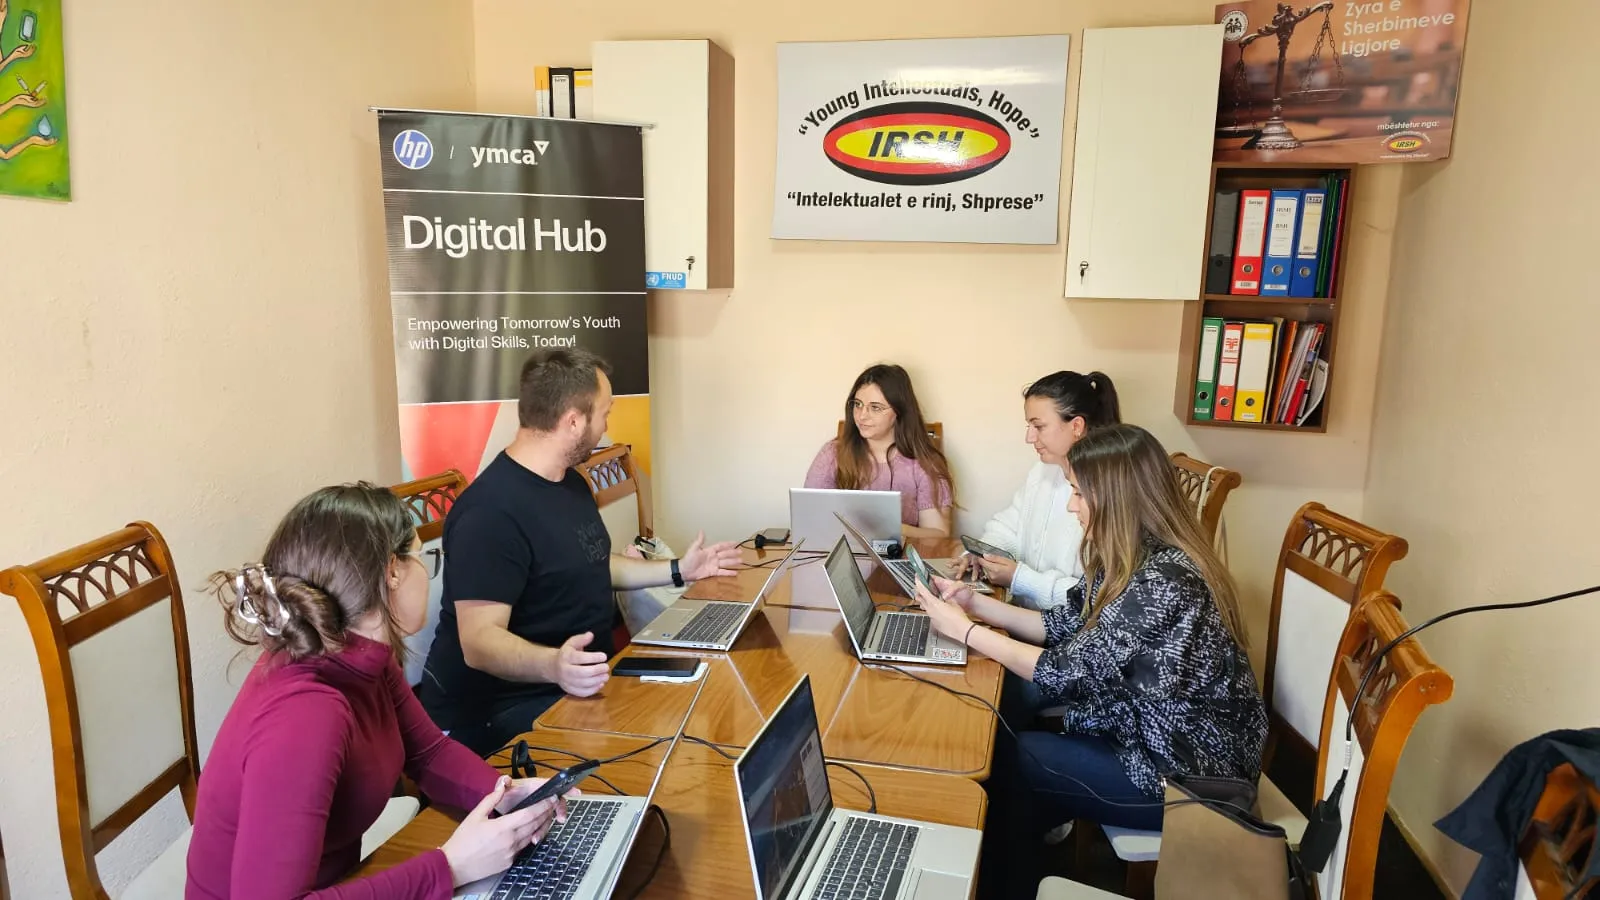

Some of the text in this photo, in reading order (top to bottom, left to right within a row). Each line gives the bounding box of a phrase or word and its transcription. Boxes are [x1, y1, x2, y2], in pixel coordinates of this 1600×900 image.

[1345, 0, 1401, 19] Zyra e
[1343, 12, 1455, 36] Sherbimeve
[1341, 38, 1401, 57] Ligjore
[798, 89, 860, 135] “Young
[988, 90, 1040, 138] Hope”
[398, 130, 429, 168] hp
[1396, 140, 1416, 148] IRSH
[470, 146, 535, 168] ymca
[787, 191, 1044, 212] “Intelektualet e rinj, Shprese”
[403, 215, 607, 258] Digital Hub
[661, 271, 683, 281] FNUD
[408, 316, 621, 333] Empowering Tomorrow's Youth
[408, 334, 576, 352] with Digital Skills, Today!
